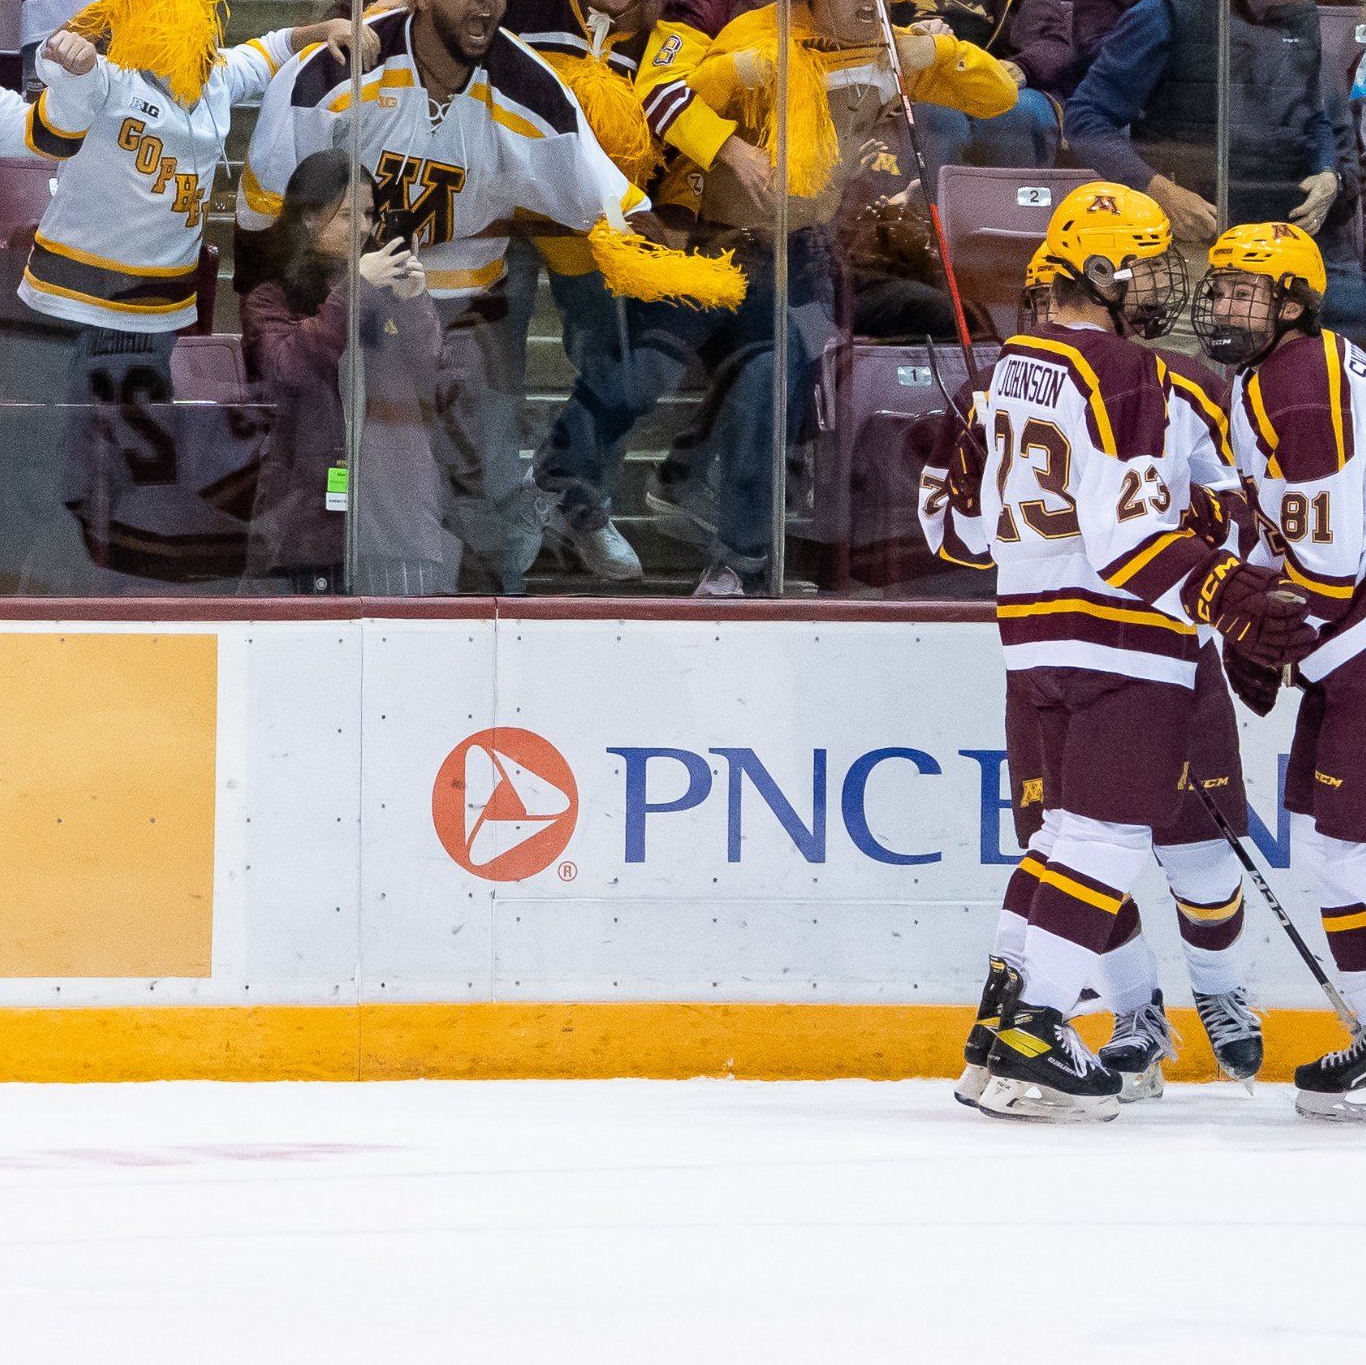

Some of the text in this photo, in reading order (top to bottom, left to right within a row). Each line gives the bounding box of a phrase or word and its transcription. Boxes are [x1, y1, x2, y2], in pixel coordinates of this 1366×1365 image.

[1028, 190, 1038, 203] 2
[1087, 195, 1121, 215] M
[910, 369, 917, 383] 1
[997, 358, 1065, 410] JOHNSON
[1115, 464, 1171, 524] 23
[1280, 491, 1334, 544] 81
[1197, 556, 1239, 623] CCM
[1245, 869, 1289, 927] CCM
